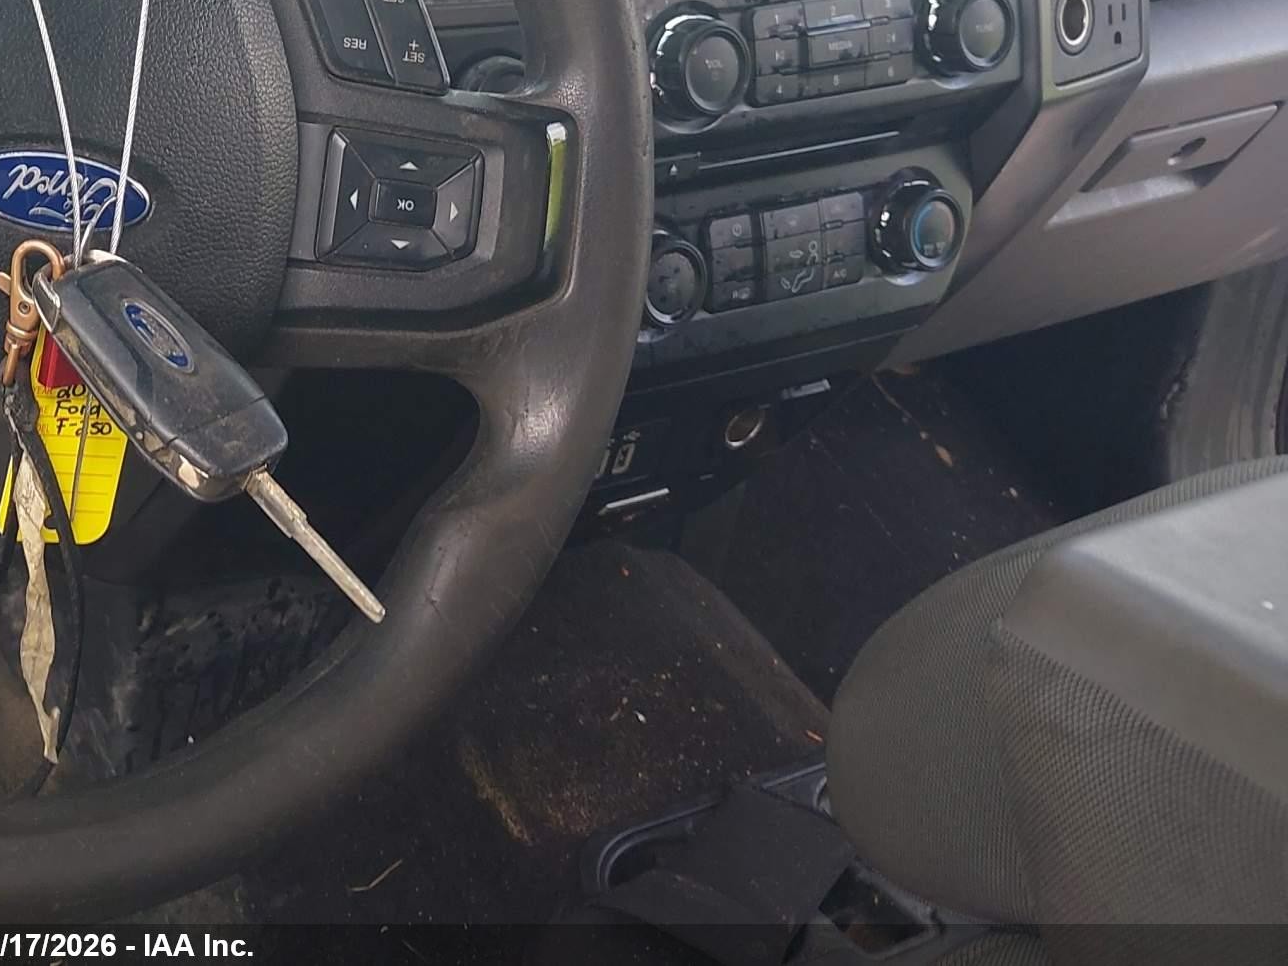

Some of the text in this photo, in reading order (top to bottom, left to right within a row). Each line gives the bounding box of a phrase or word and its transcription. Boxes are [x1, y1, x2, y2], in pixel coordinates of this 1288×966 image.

[343, 36, 367, 50] RES
[402, 50, 425, 63] SET
[396, 198, 415, 212] OK
[54, 399, 101, 420] Ford
